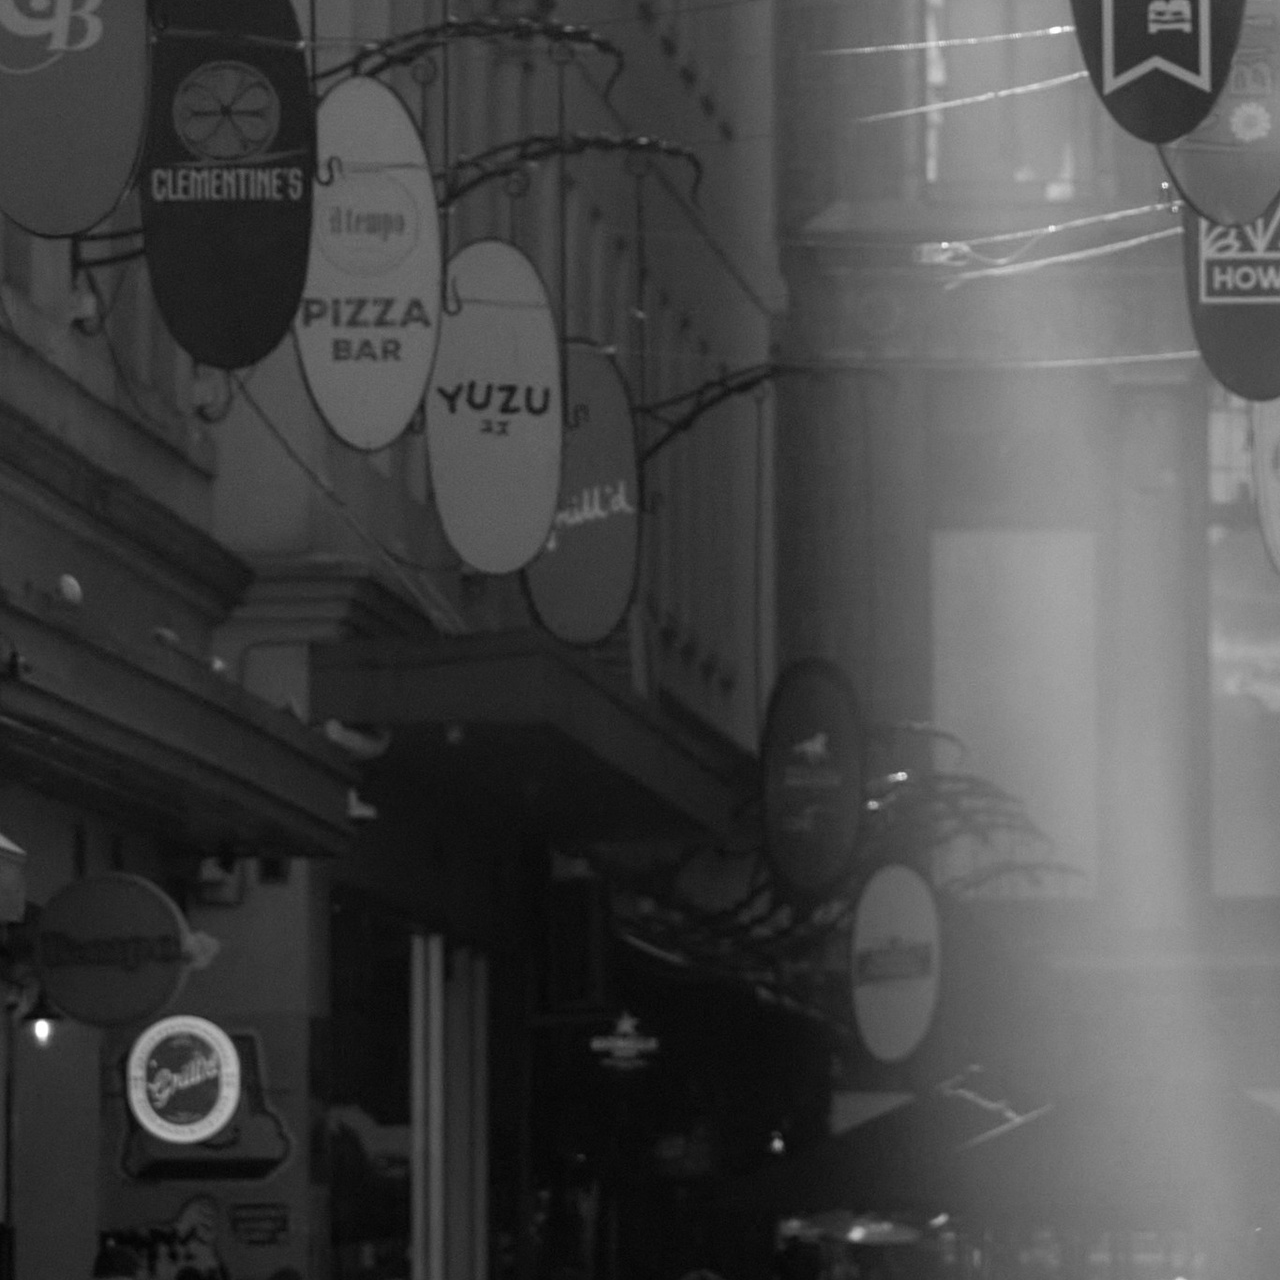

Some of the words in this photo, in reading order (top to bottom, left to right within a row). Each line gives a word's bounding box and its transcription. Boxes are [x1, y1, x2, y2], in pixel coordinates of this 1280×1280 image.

[151, 167, 304, 202] CLEMENTINE'S
[301, 296, 432, 329] PIZZA
[331, 338, 403, 364] BAR
[435, 380, 551, 416] YUZU
